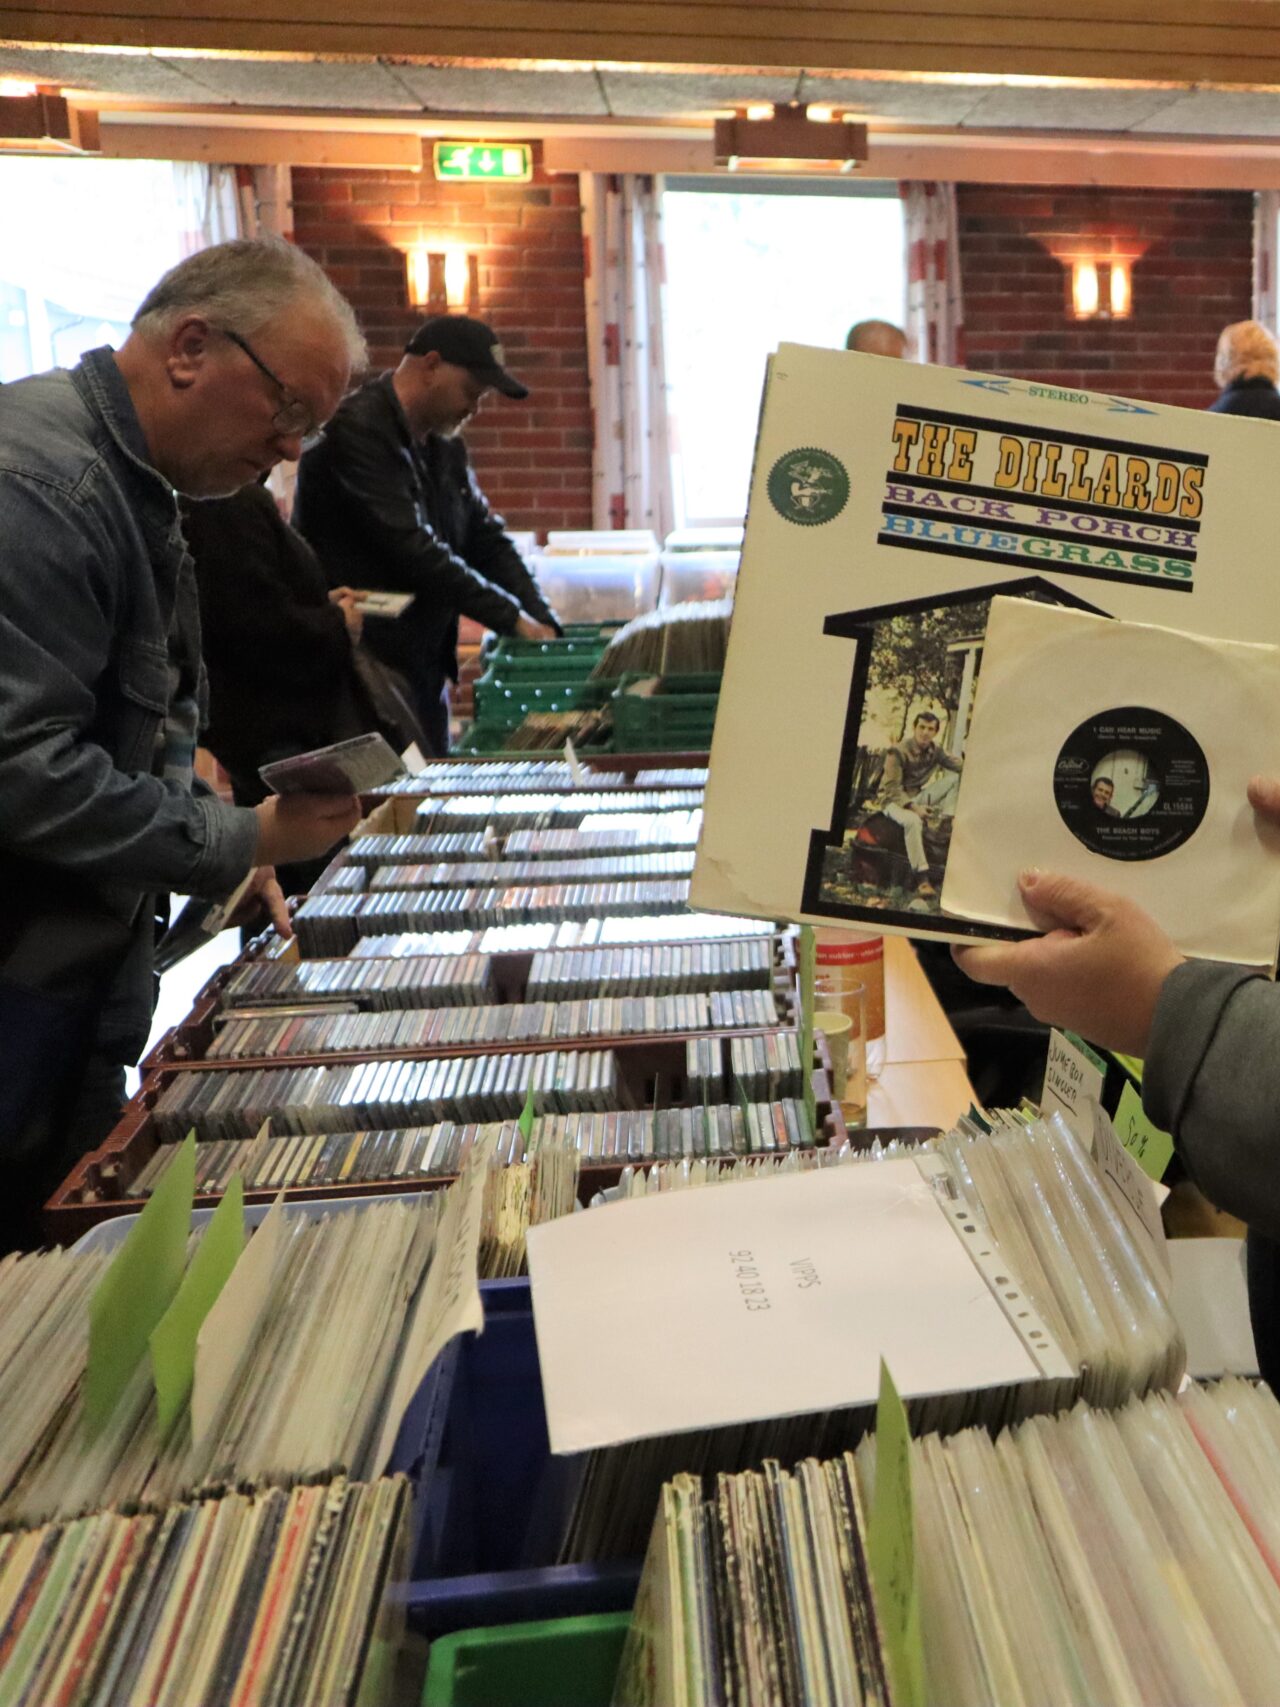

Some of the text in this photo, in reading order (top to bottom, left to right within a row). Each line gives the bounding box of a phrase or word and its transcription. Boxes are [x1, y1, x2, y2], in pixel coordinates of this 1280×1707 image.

[1029, 386, 1089, 405] STEREO
[892, 418, 1206, 518] THE DILLARDS
[881, 514, 1194, 579] BLUEGRASS
[884, 485, 1016, 520] BACK
[1036, 507, 1198, 549] PORCH
[728, 1249, 771, 1311] 92 40 18 23
[789, 1256, 822, 1289] VIPPS
